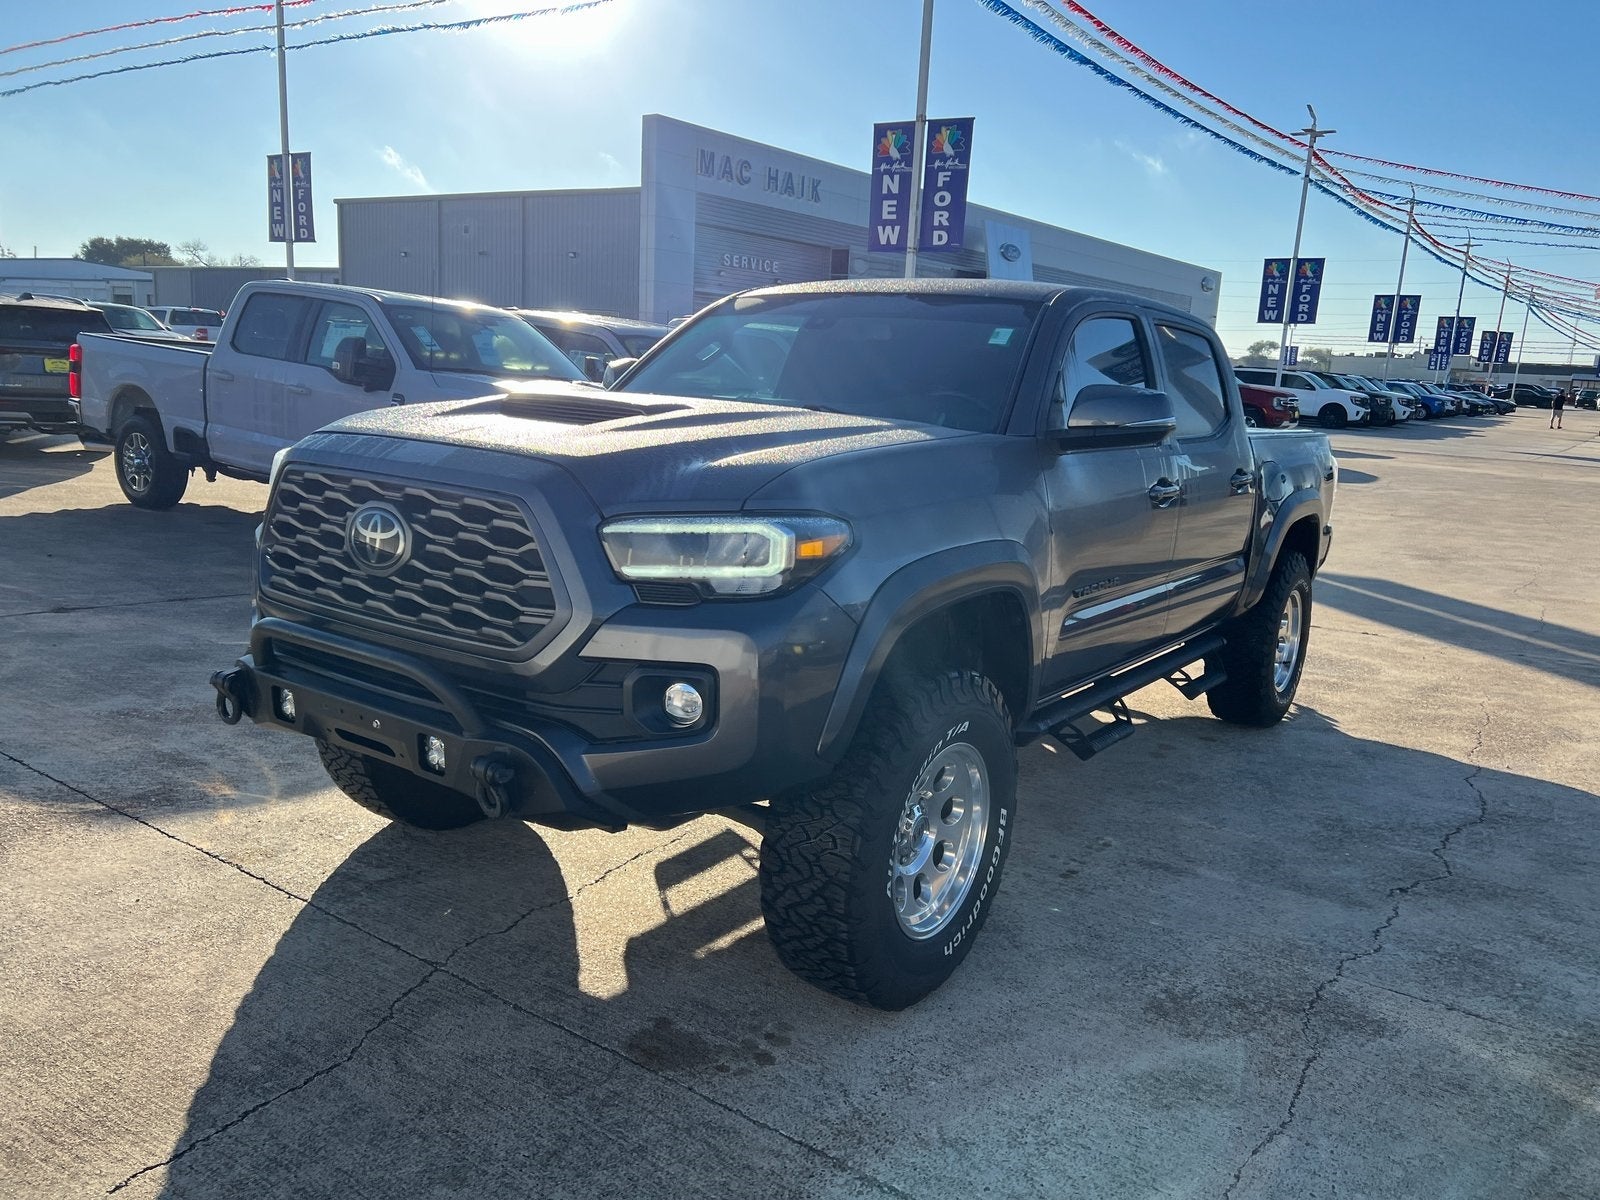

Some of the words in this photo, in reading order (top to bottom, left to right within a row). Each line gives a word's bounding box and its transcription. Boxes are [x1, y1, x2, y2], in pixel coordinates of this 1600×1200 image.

[697, 148, 752, 186] MAC
[764, 165, 822, 203] HAIK
[272, 189, 284, 237] NEW
[298, 189, 308, 238] FORD
[877, 174, 901, 245] NEW
[932, 171, 952, 246] FORD
[723, 253, 779, 273] SERVICE
[1264, 284, 1279, 321] NEW
[1297, 284, 1312, 322] FORD
[1373, 313, 1386, 341] NEW
[1399, 314, 1411, 342] FORD
[1437, 331, 1448, 353] NEW
[1458, 332, 1468, 354] FORD
[1481, 343, 1490, 361] NEW
[1498, 343, 1506, 362] FORD
[945, 721, 970, 741] T/A
[943, 807, 1007, 956] BFGoodrich
